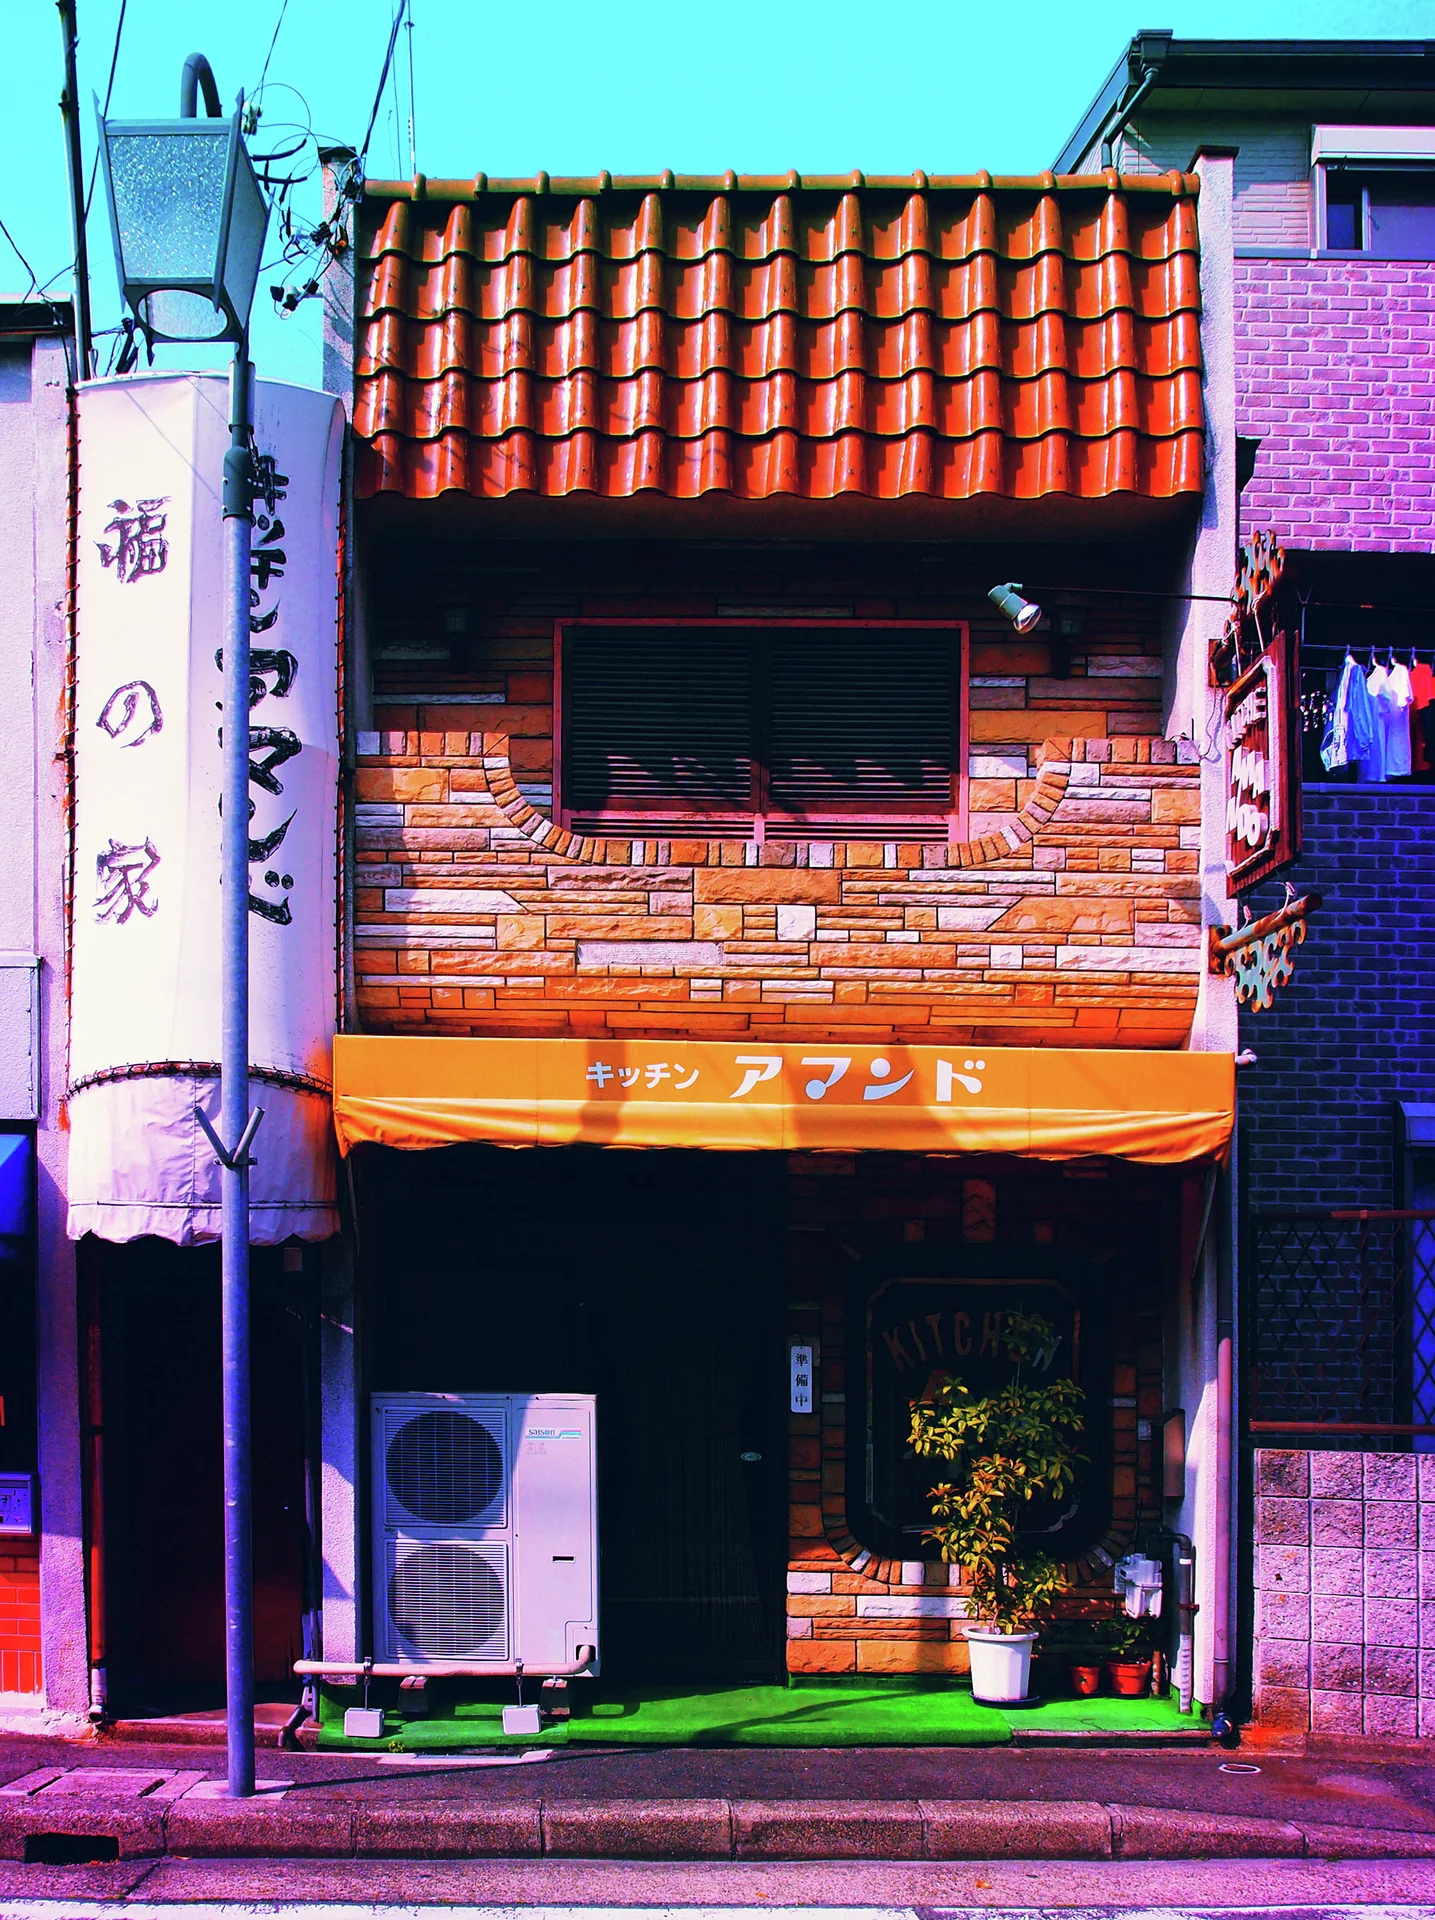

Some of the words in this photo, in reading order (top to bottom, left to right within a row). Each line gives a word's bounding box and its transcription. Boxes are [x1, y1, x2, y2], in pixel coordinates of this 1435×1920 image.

[92, 495, 172, 926] 福の家
[585, 1061, 700, 1089] キッチン
[728, 1055, 987, 1102] アマンド
[882, 1311, 1064, 1374] KITCHN
[795, 1353, 808, 1407] 準備中
